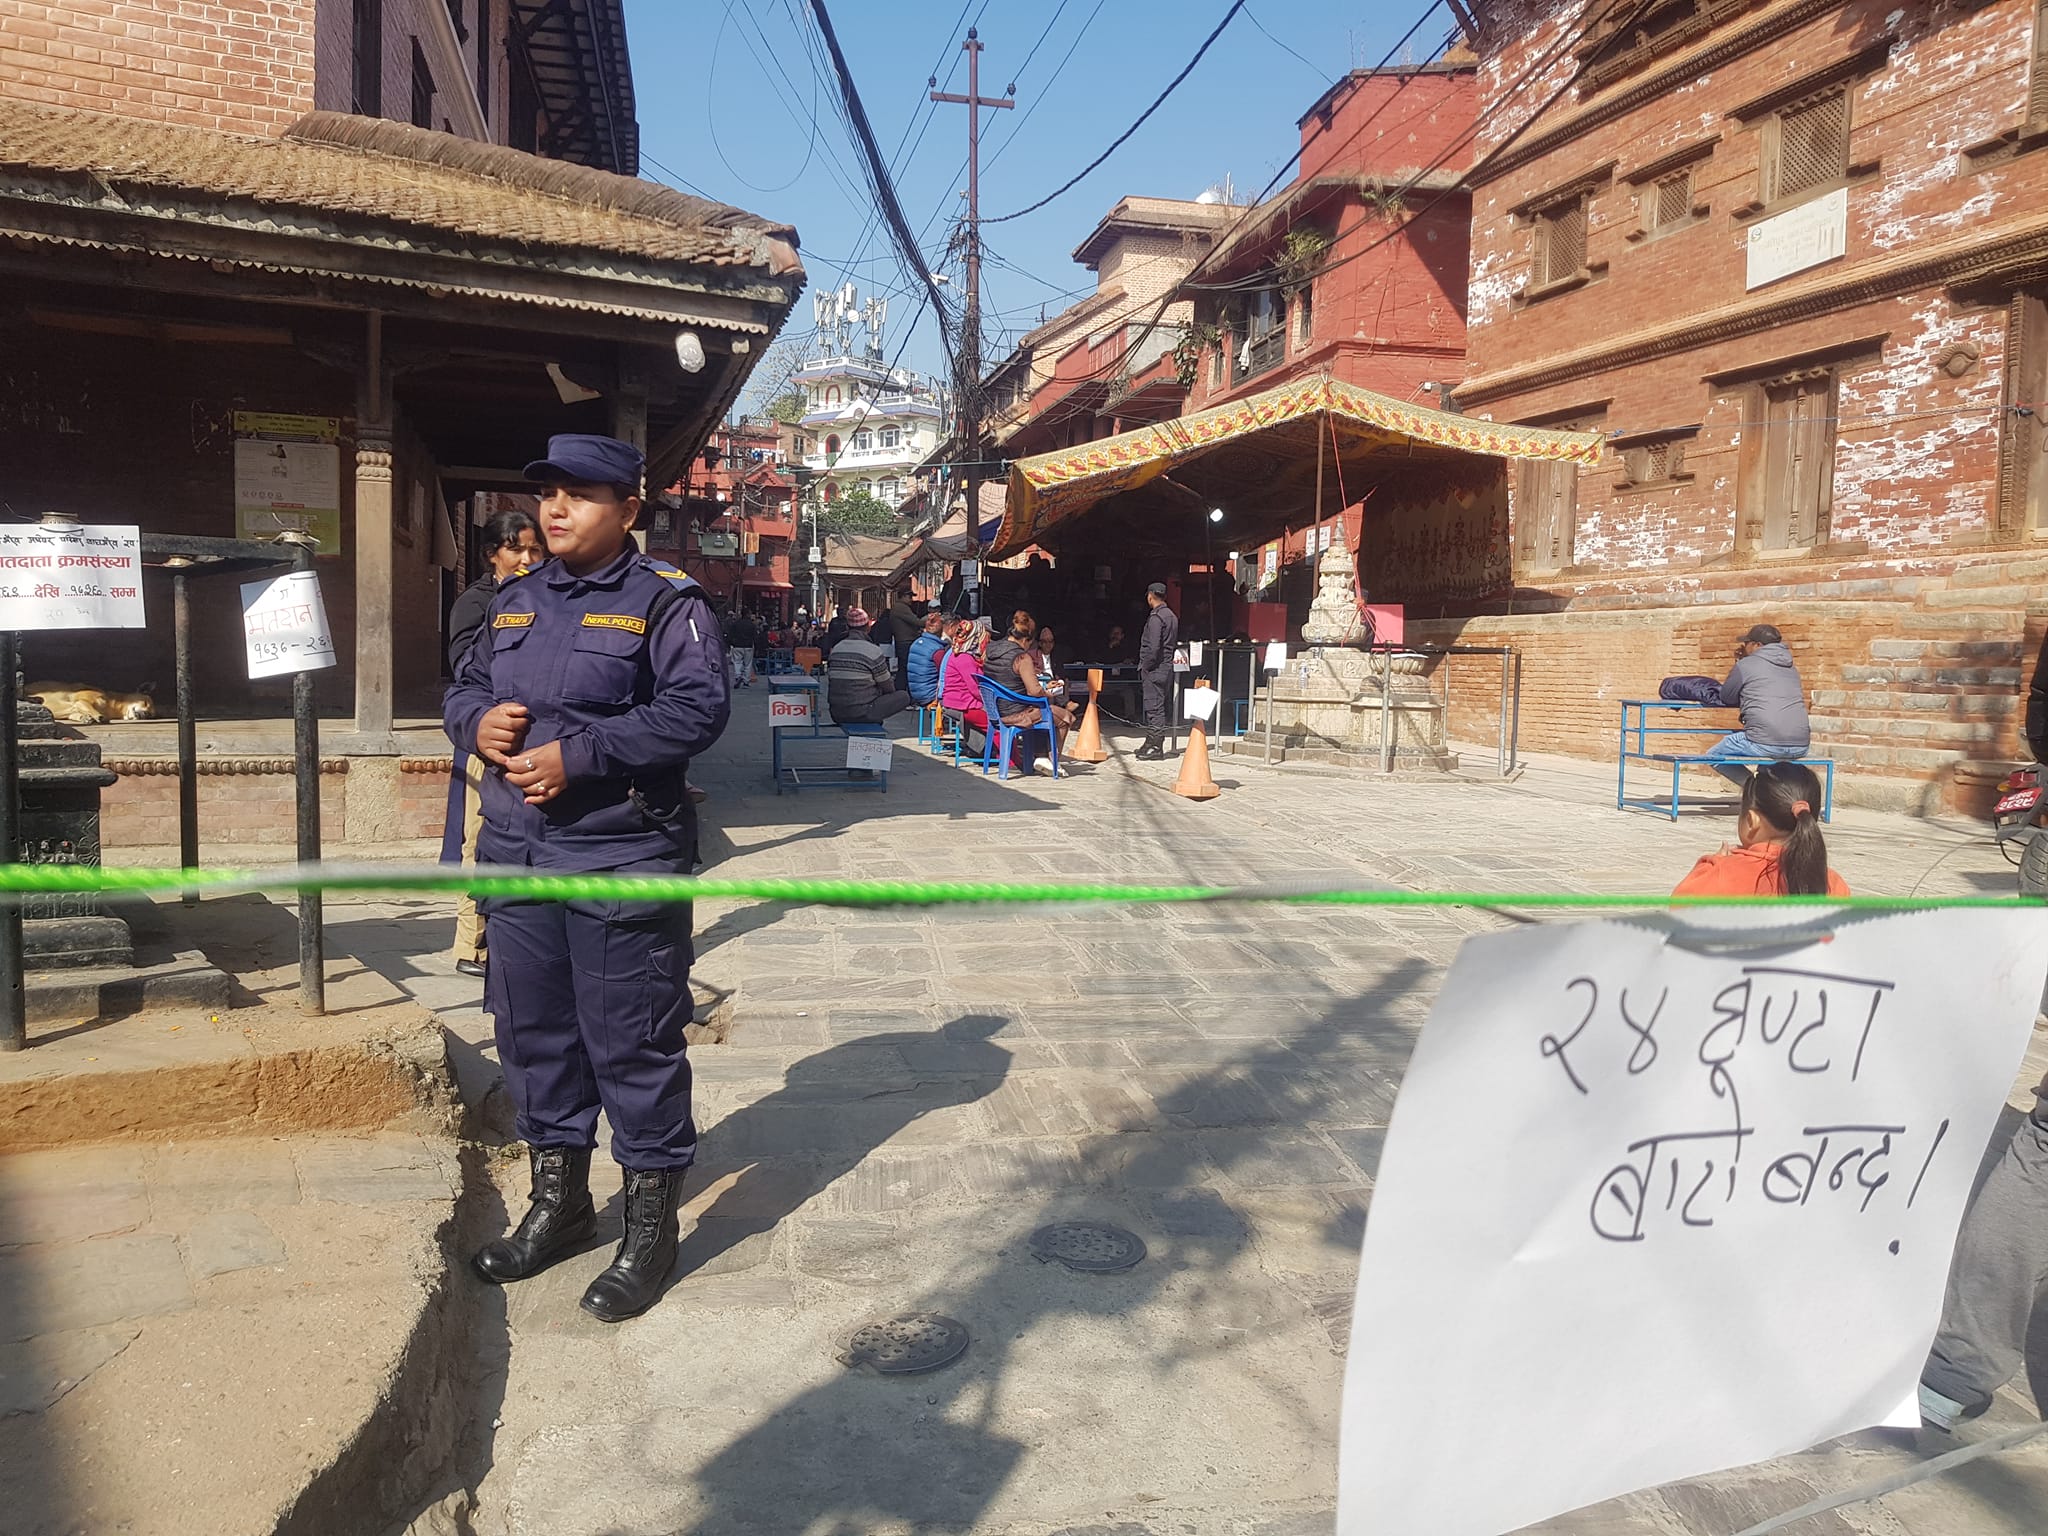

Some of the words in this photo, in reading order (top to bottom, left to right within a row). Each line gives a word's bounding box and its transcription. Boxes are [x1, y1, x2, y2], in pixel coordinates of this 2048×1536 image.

[57, 554, 131, 568] क्रमसंख्या
[34, 583, 60, 598] देखि
[110, 586, 136, 599] सम्म
[245, 604, 312, 634] मतदान
[586, 616, 610, 625] NEPAL
[611, 617, 643, 630] POLICE
[772, 701, 807, 717] भित्र
